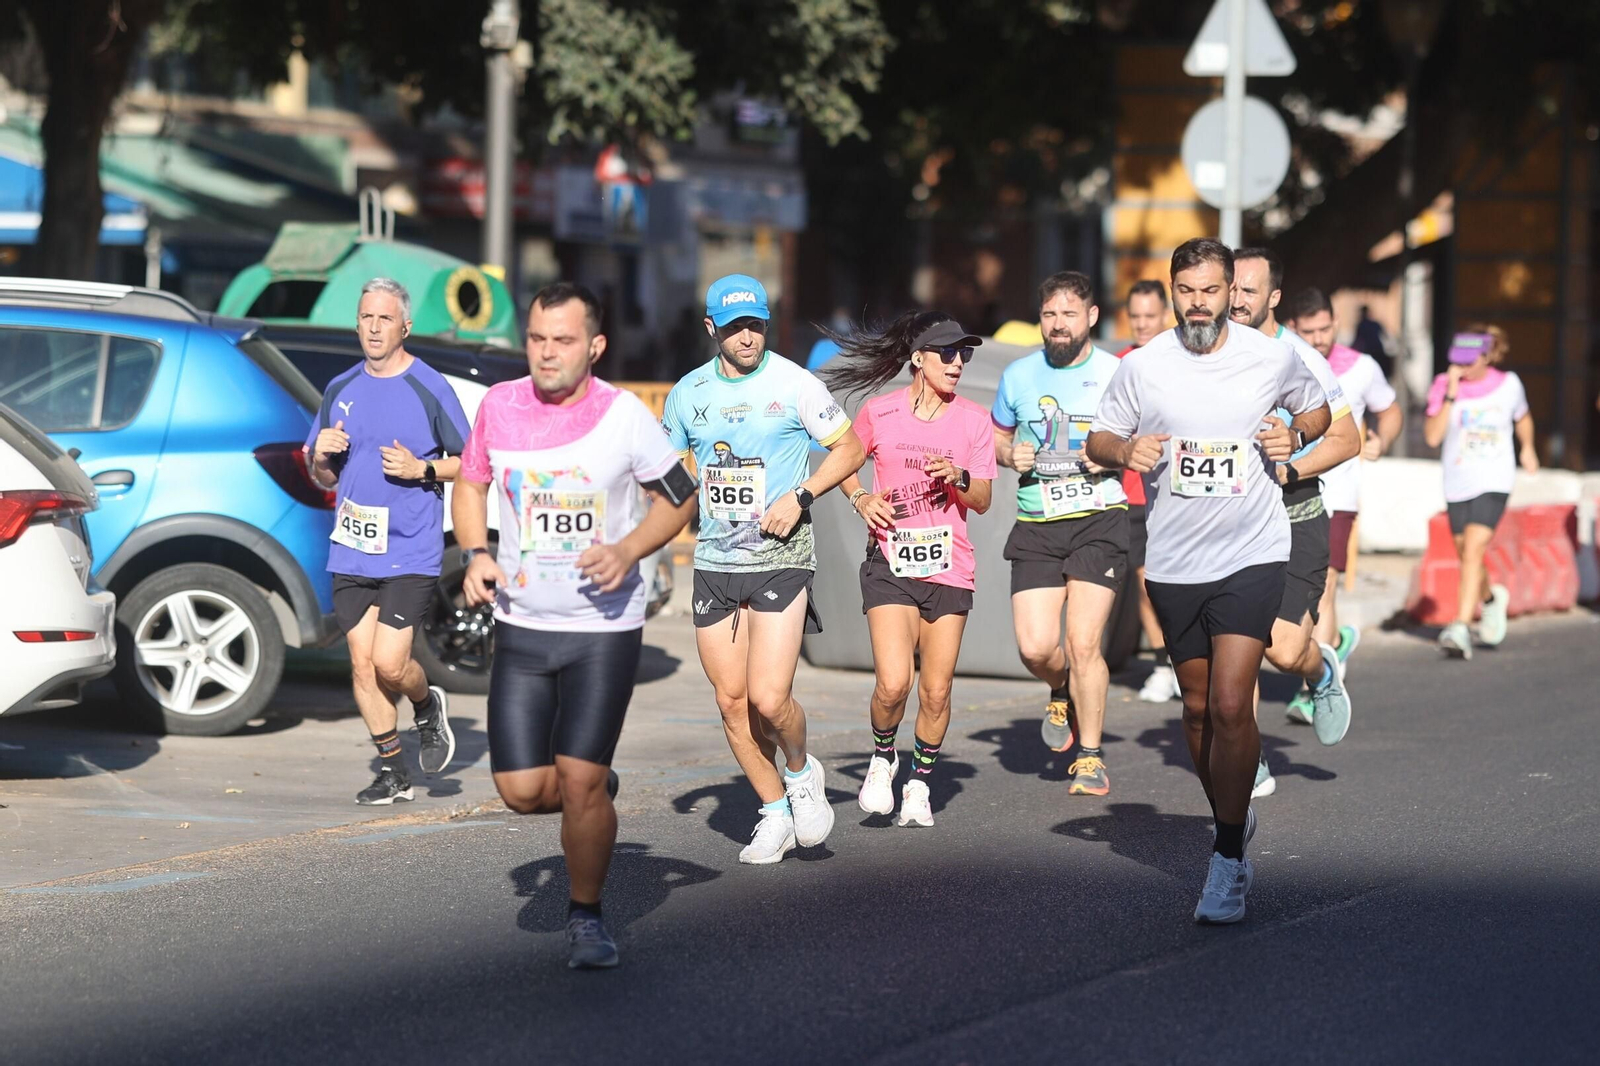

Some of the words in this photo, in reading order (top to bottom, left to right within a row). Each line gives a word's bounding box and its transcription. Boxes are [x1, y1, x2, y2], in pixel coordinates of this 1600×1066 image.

[722, 291, 756, 307] HOKA
[726, 411, 747, 420] PARK
[907, 444, 943, 456] GENERALI
[1180, 457, 1234, 478] 641
[707, 469, 721, 482] XII
[531, 492, 553, 506] XII
[710, 486, 754, 505] 366
[1050, 482, 1093, 501] 555
[358, 512, 378, 520] 2025
[536, 512, 593, 533] 180
[341, 516, 378, 539] 456
[896, 532, 911, 542] XII
[921, 532, 943, 541] 2025
[898, 543, 943, 562] 466
